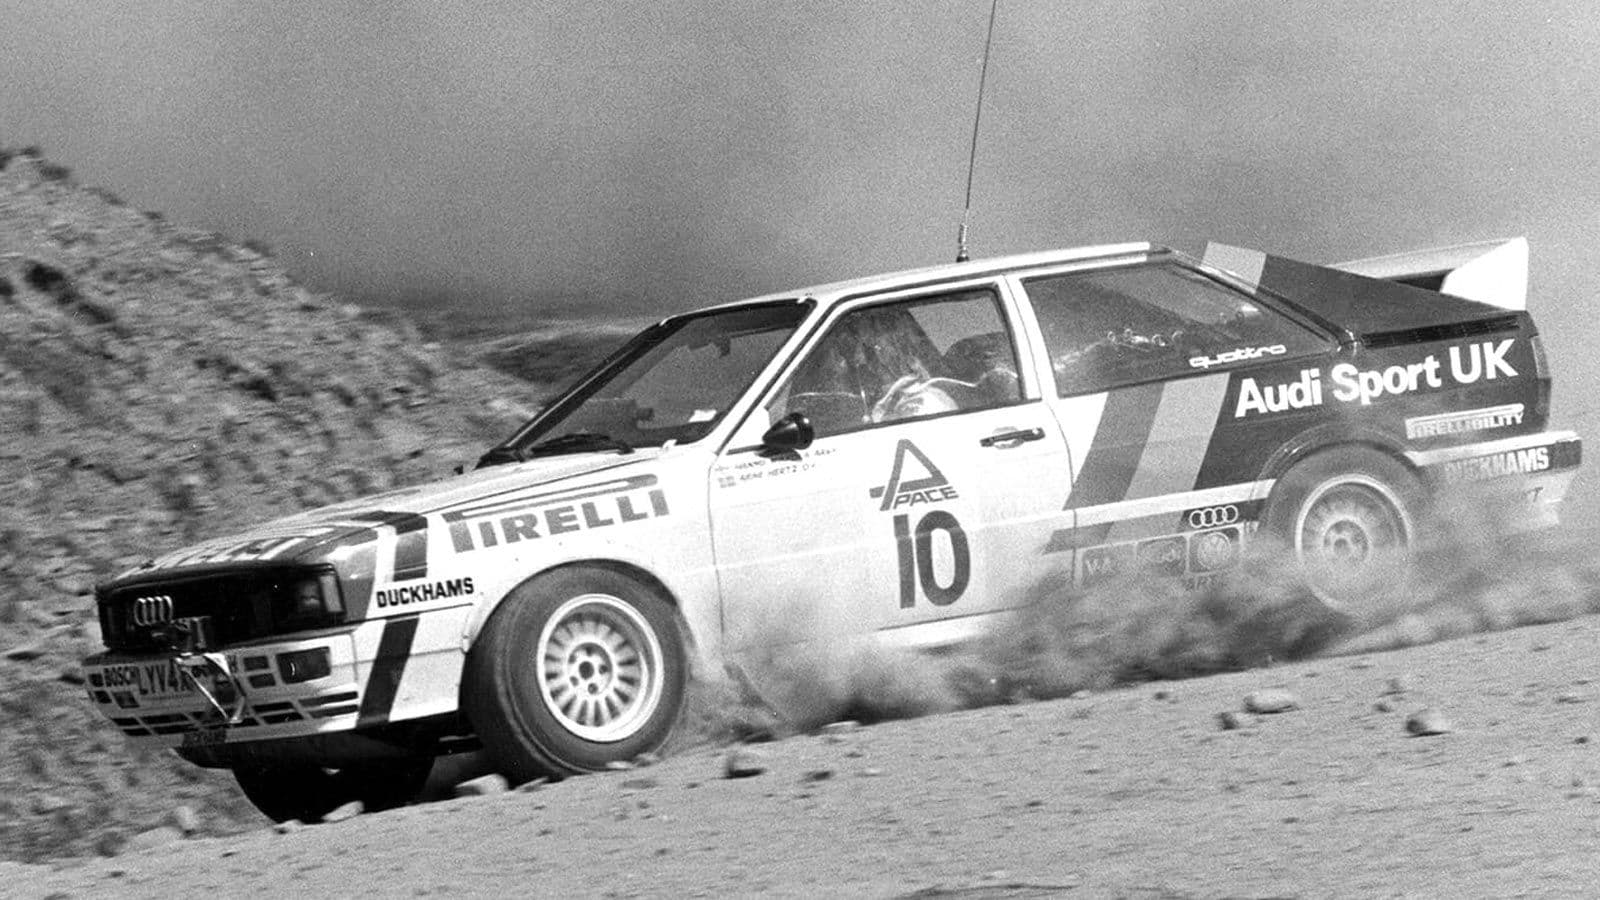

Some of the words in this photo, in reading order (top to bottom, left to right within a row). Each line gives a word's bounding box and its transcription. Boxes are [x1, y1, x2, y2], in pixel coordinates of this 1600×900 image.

[1188, 344, 1287, 369] quattro
[1235, 368, 1323, 418] Audi
[1331, 355, 1442, 405] Sport
[1449, 339, 1519, 384] UK
[441, 473, 670, 553] PIRELLI
[892, 486, 959, 510] PACE
[893, 510, 971, 609] 10
[376, 577, 474, 609] DUCKHAMS
